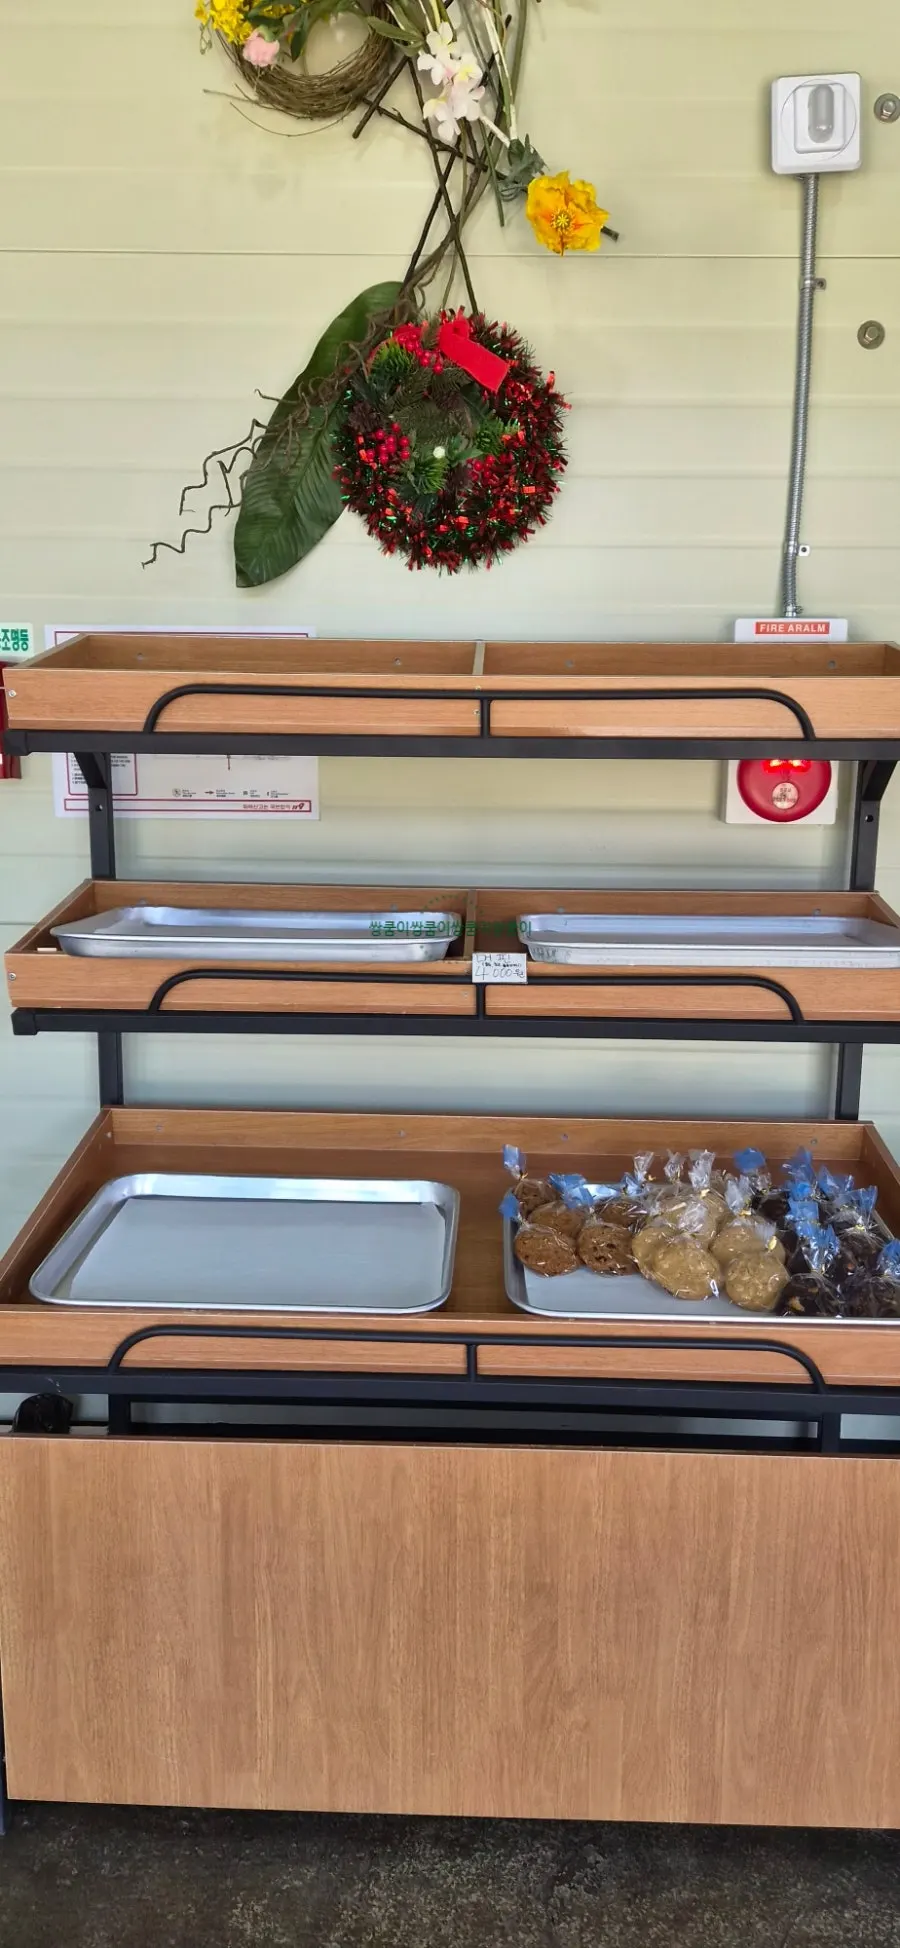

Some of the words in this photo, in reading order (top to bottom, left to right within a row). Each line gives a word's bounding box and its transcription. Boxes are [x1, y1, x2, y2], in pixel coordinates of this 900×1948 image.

[759, 624, 784, 633] FIRE
[788, 624, 826, 632] ARALM
[0, 629, 29, 651] 조명등
